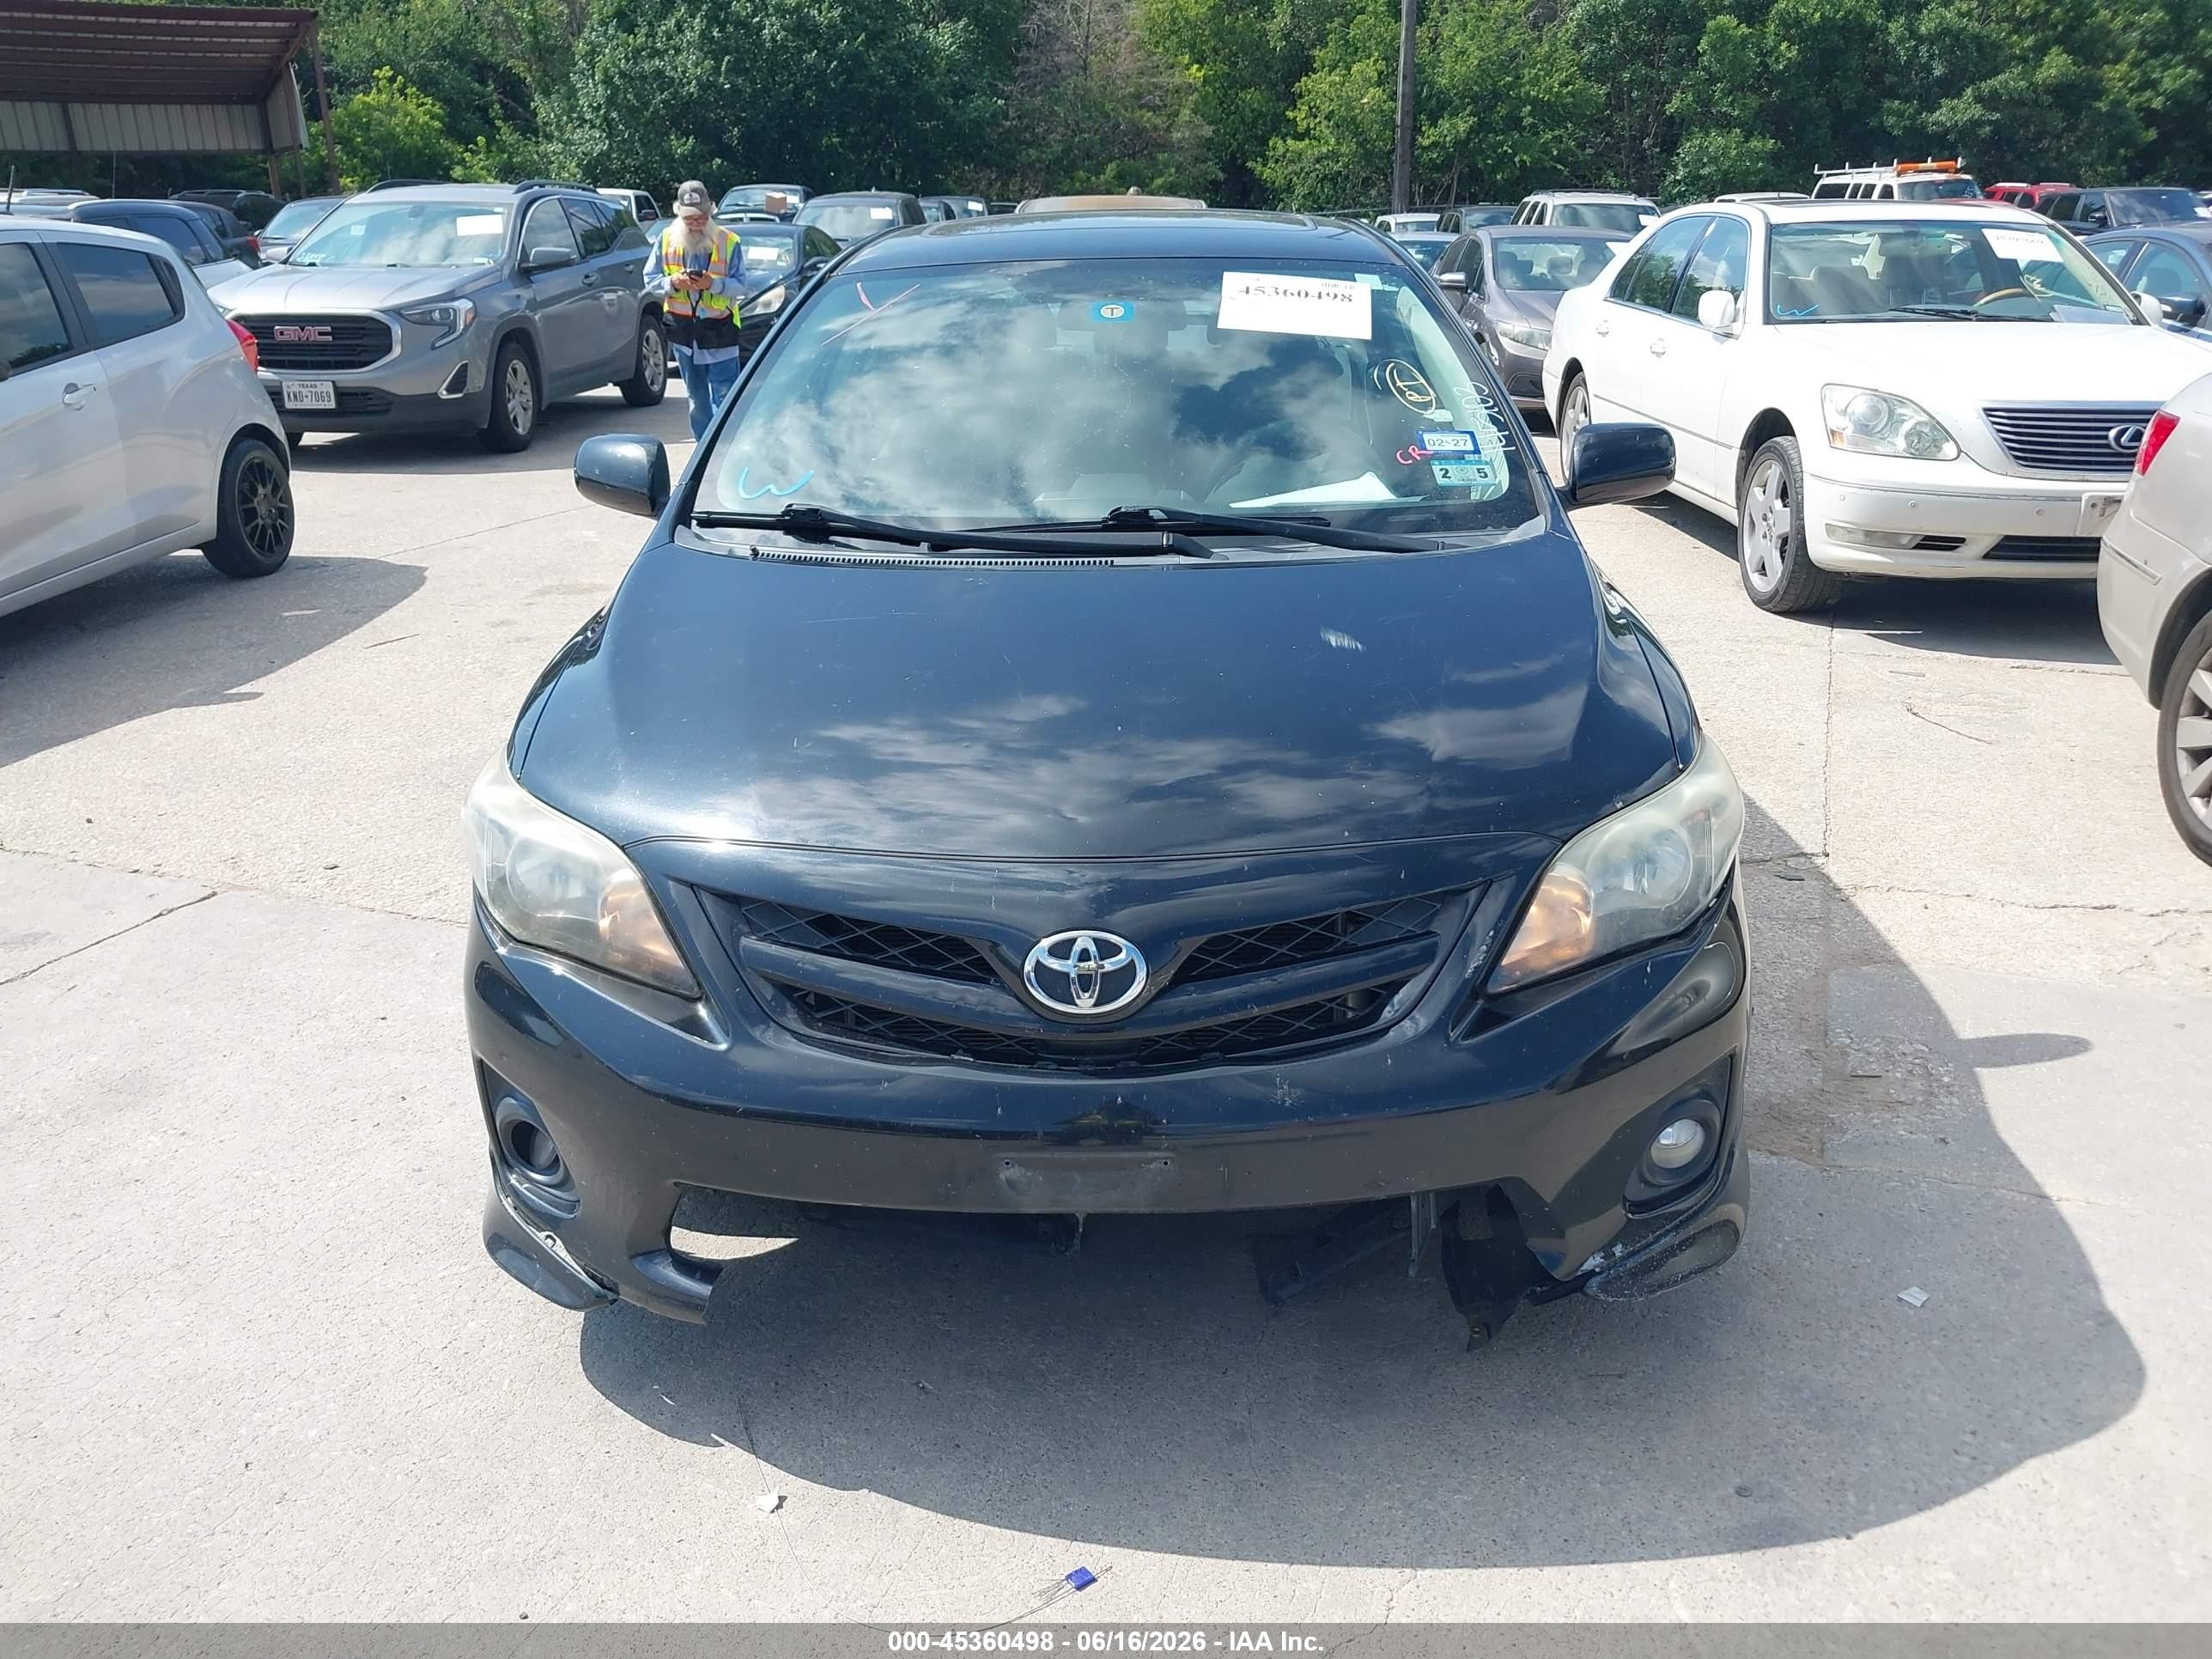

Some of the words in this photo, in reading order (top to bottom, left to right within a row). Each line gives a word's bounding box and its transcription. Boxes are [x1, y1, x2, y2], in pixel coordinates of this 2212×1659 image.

[1237, 285, 1354, 303] 45360498
[274, 325, 333, 342] GMC
[1438, 467, 1452, 479] 2
[1475, 467, 1489, 479] 5
